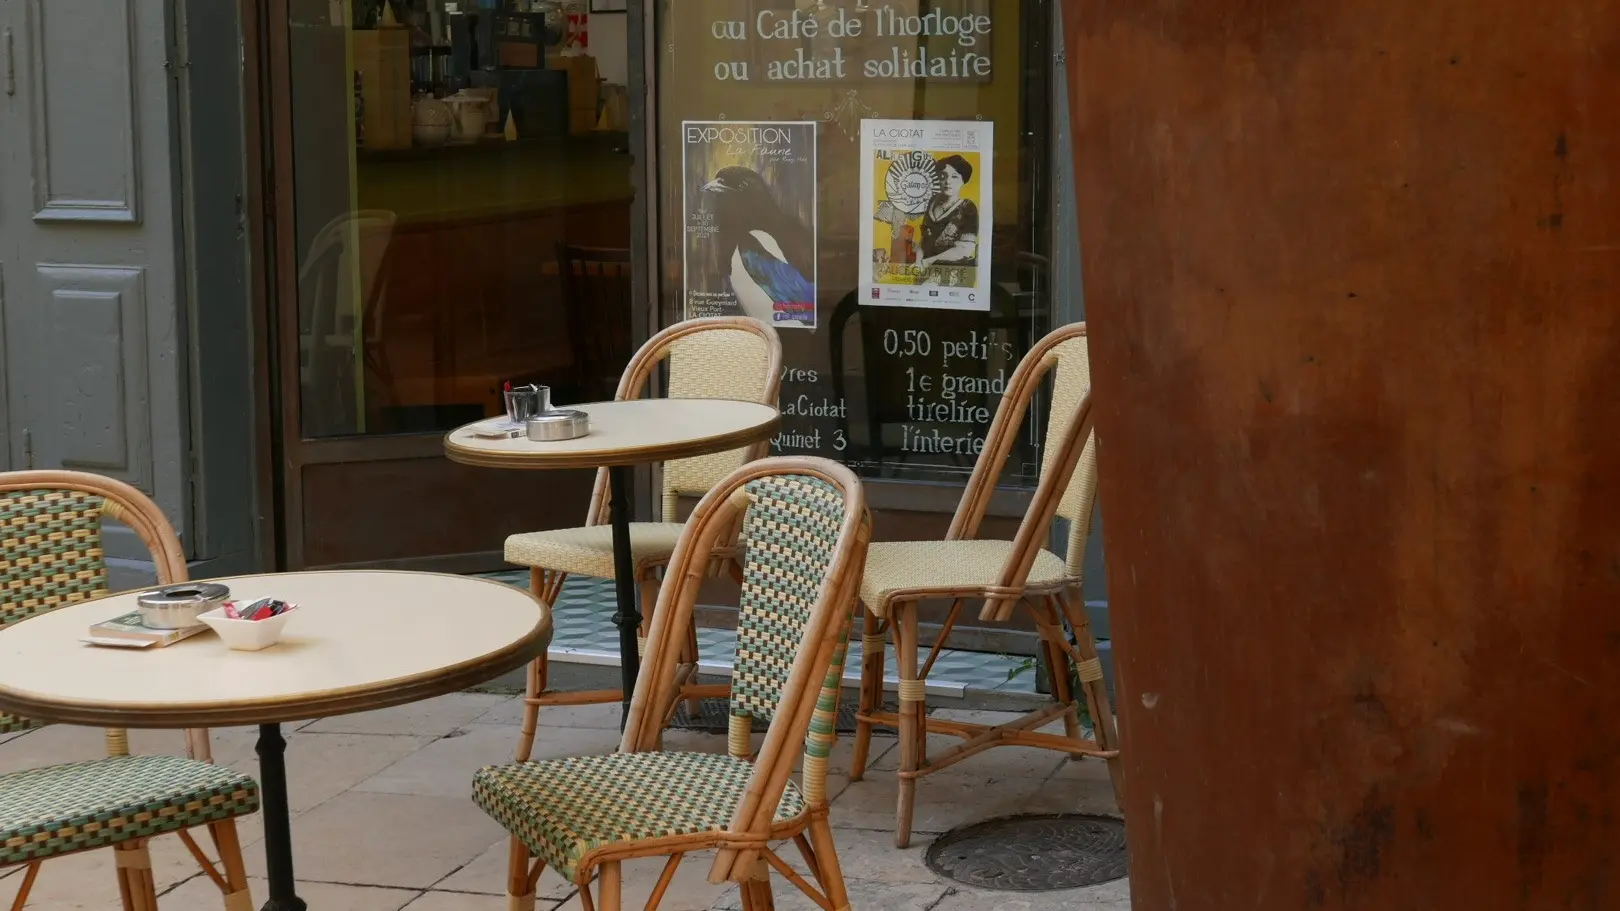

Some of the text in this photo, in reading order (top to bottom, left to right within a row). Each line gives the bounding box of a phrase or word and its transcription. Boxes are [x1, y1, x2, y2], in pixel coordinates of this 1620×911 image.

[711, 5, 992, 46] au Café de l'horloge
[714, 46, 991, 81] ou achat solidaire
[687, 127, 791, 144] EXPOSITION
[873, 129, 886, 138] LA
[889, 129, 924, 139] CIOTAT
[883, 329, 931, 358] 0,50
[941, 368, 1008, 400] grand
[906, 395, 990, 424] tirelire
[832, 428, 847, 451] 3
[900, 424, 984, 455] l'interie
